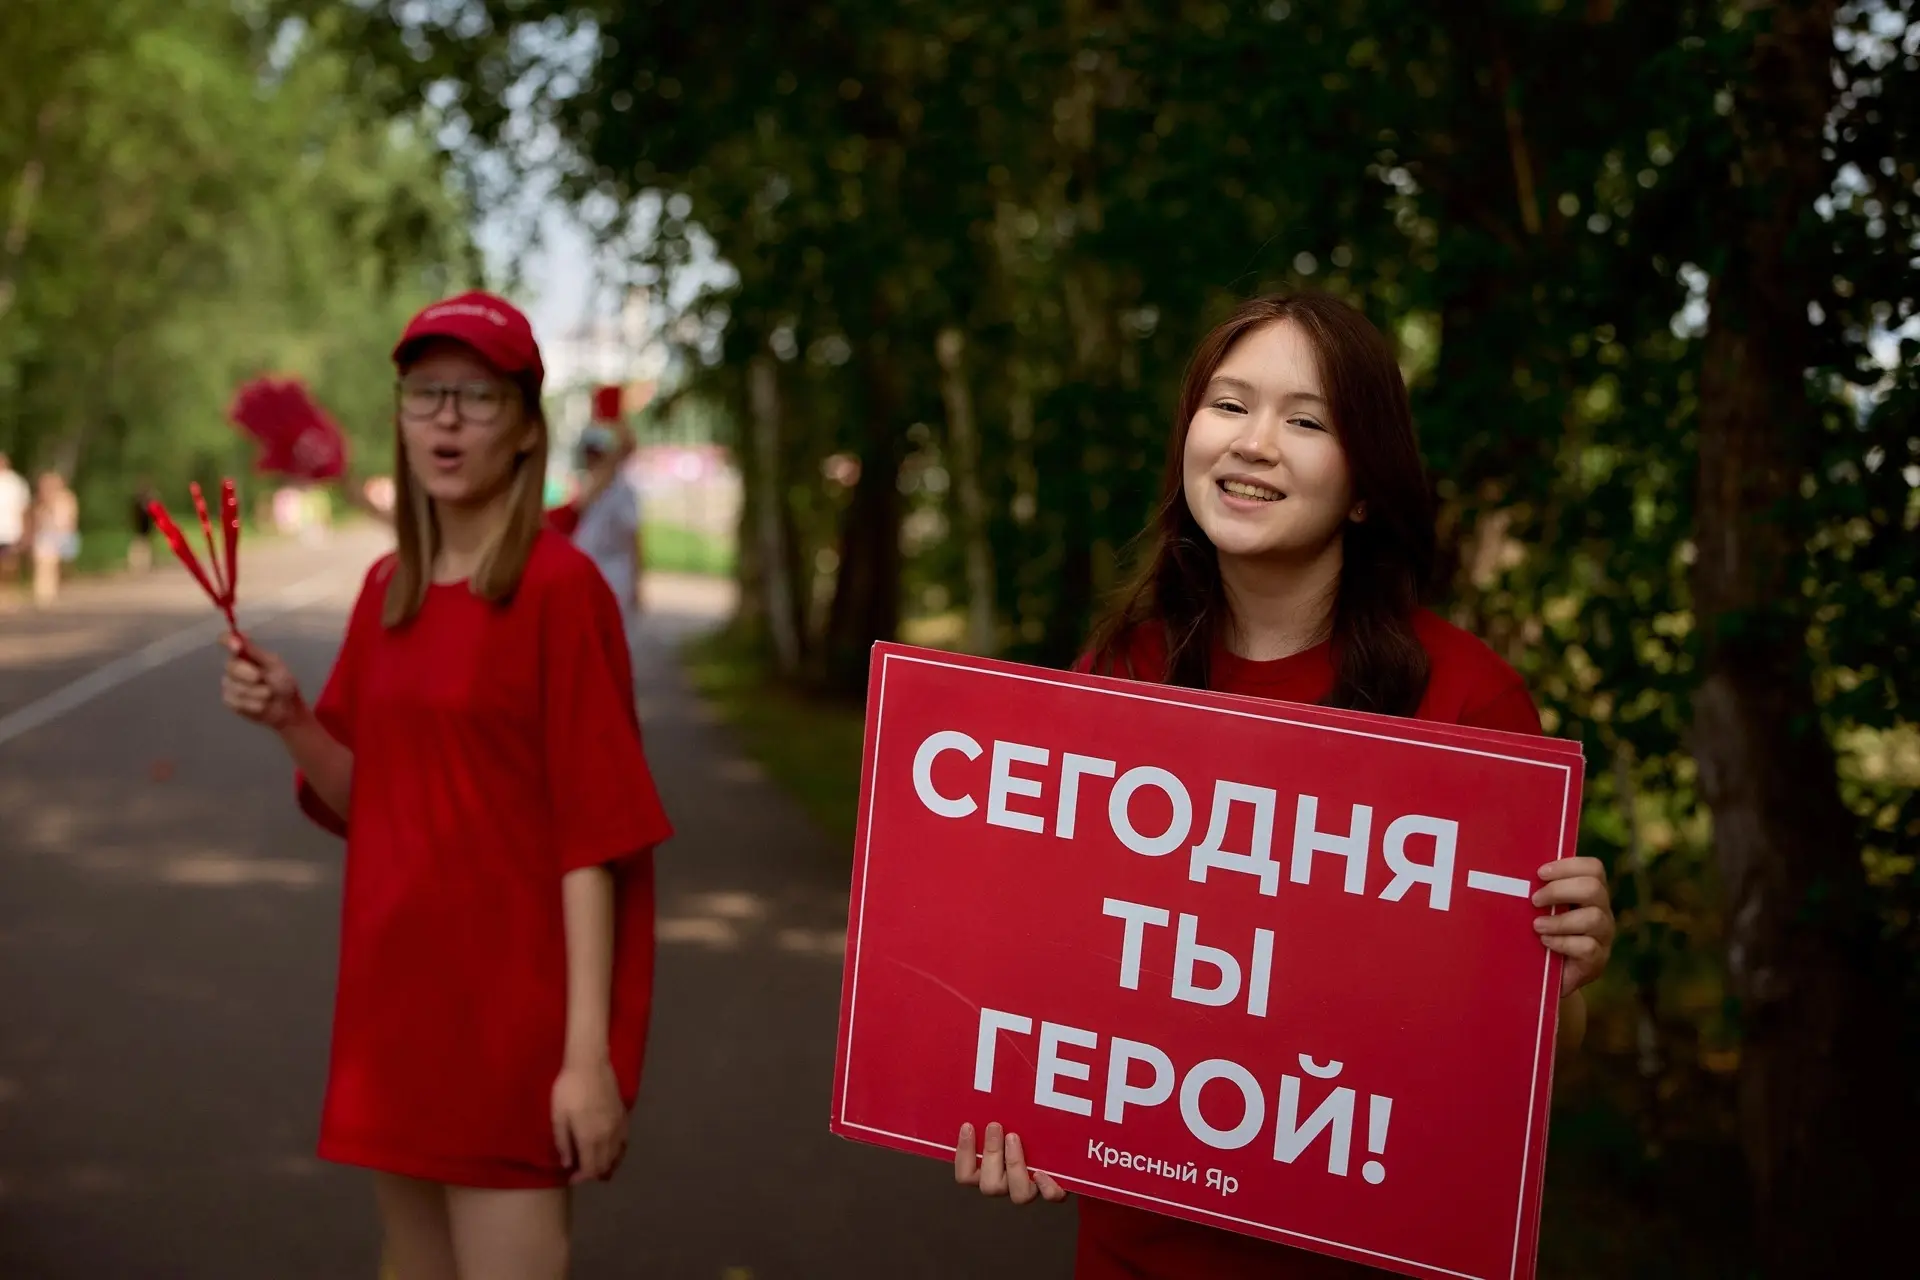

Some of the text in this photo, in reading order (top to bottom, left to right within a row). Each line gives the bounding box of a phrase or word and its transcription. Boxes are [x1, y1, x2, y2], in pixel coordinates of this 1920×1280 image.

[1102, 897, 1275, 1018] ТЫ
[973, 1007, 1393, 1185] ГЕРОЙ!
[1087, 1138, 1239, 1197] Красный Яр
